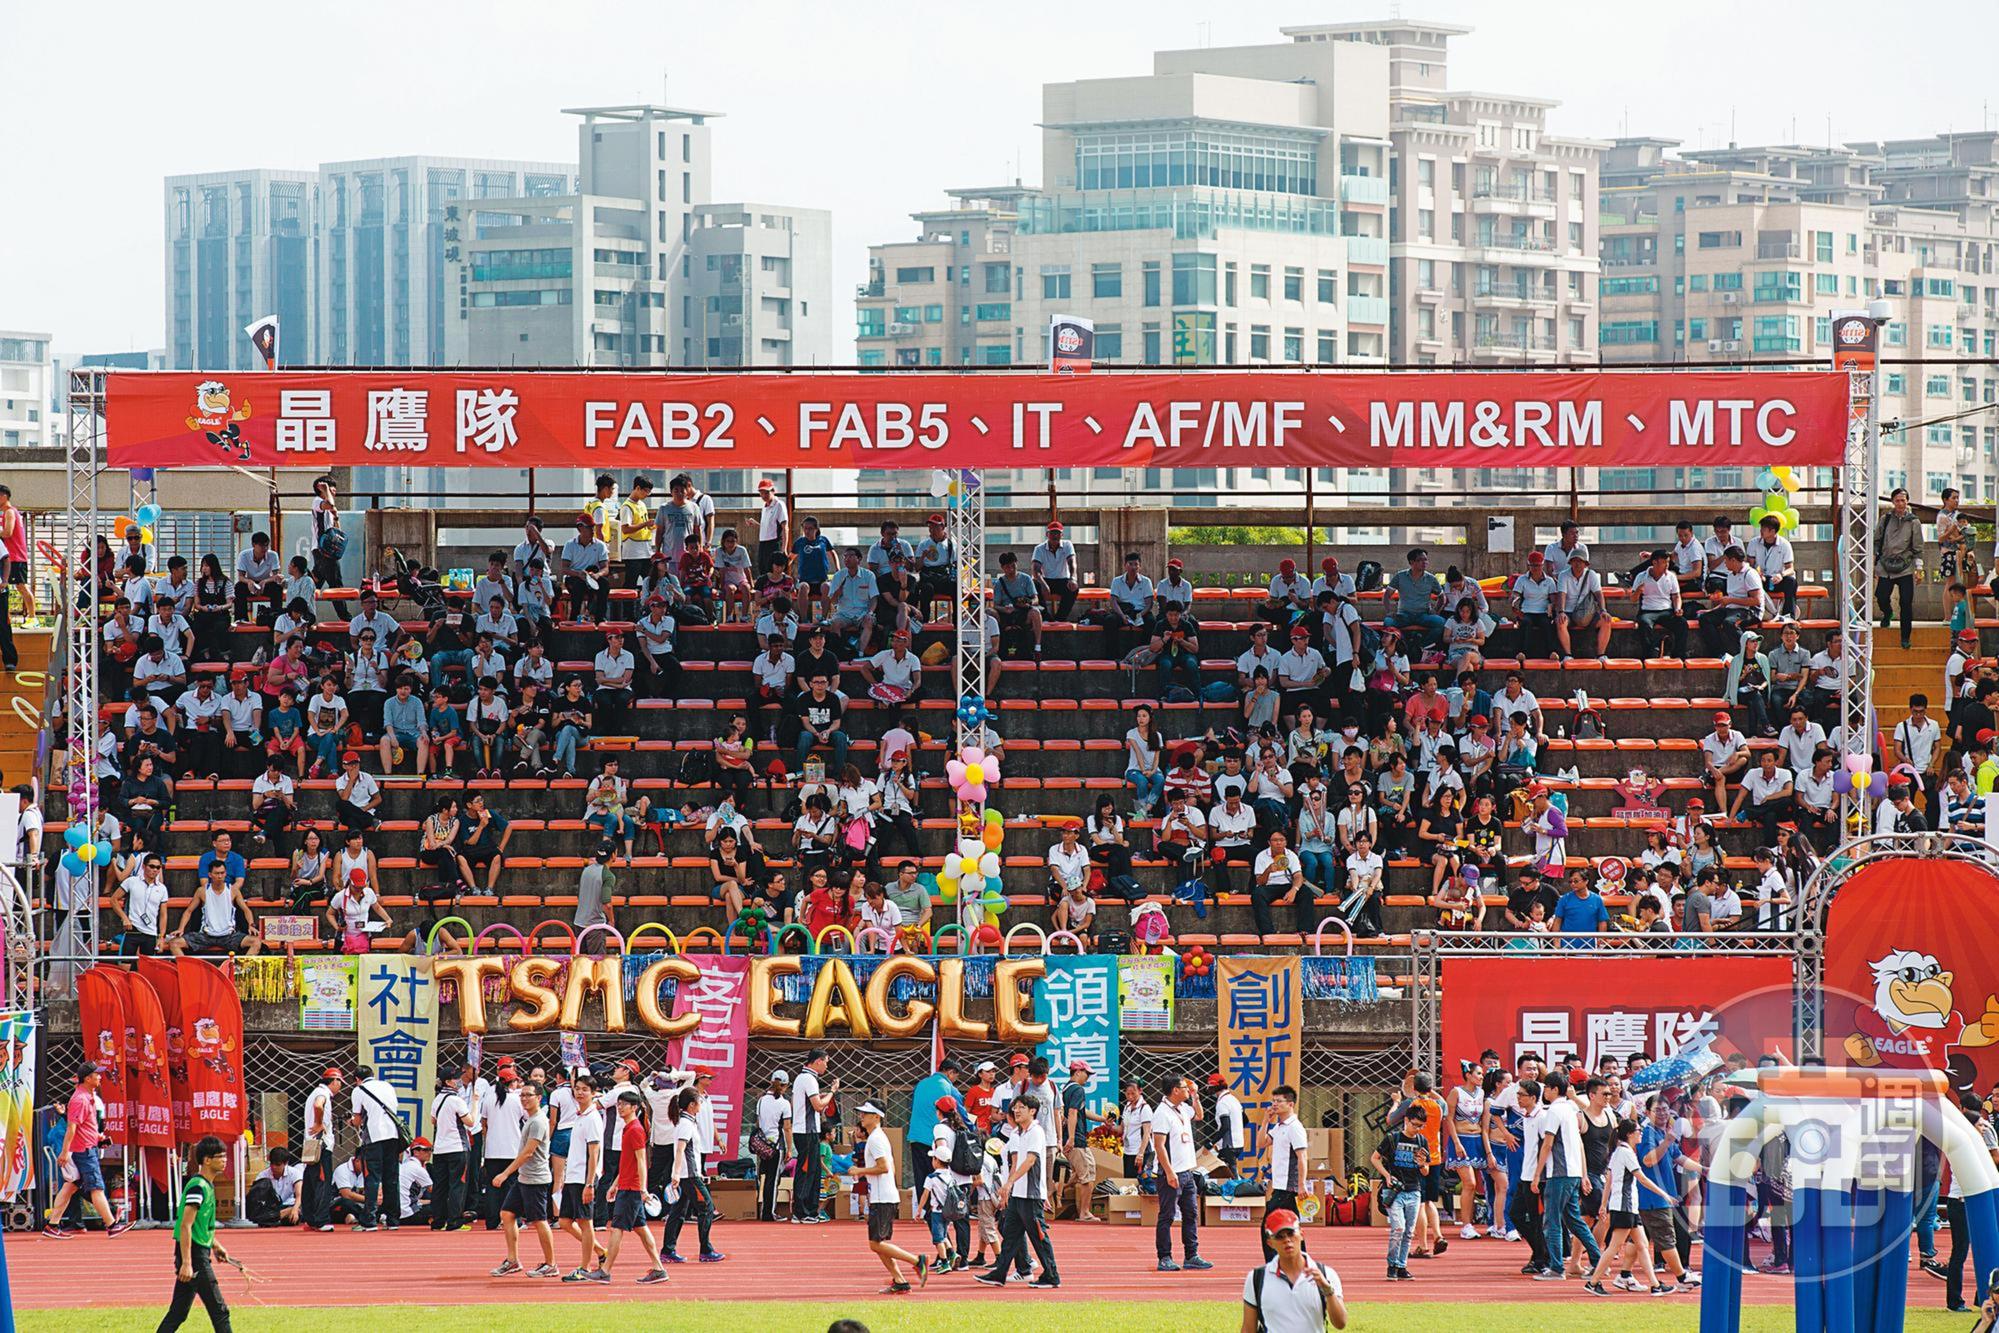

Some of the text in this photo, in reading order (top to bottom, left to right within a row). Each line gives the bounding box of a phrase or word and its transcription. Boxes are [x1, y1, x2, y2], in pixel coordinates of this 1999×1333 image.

[276, 387, 519, 452] 晶鷹隊
[1670, 400, 1796, 446] MTC
[433, 955, 1049, 1043] TSMC EAGLE
[1043, 966, 1111, 1115] 領導
[193, 1090, 238, 1109] 晶鷹隊
[200, 1109, 230, 1121] EAGLE
[139, 1123, 169, 1135] EAGLE
